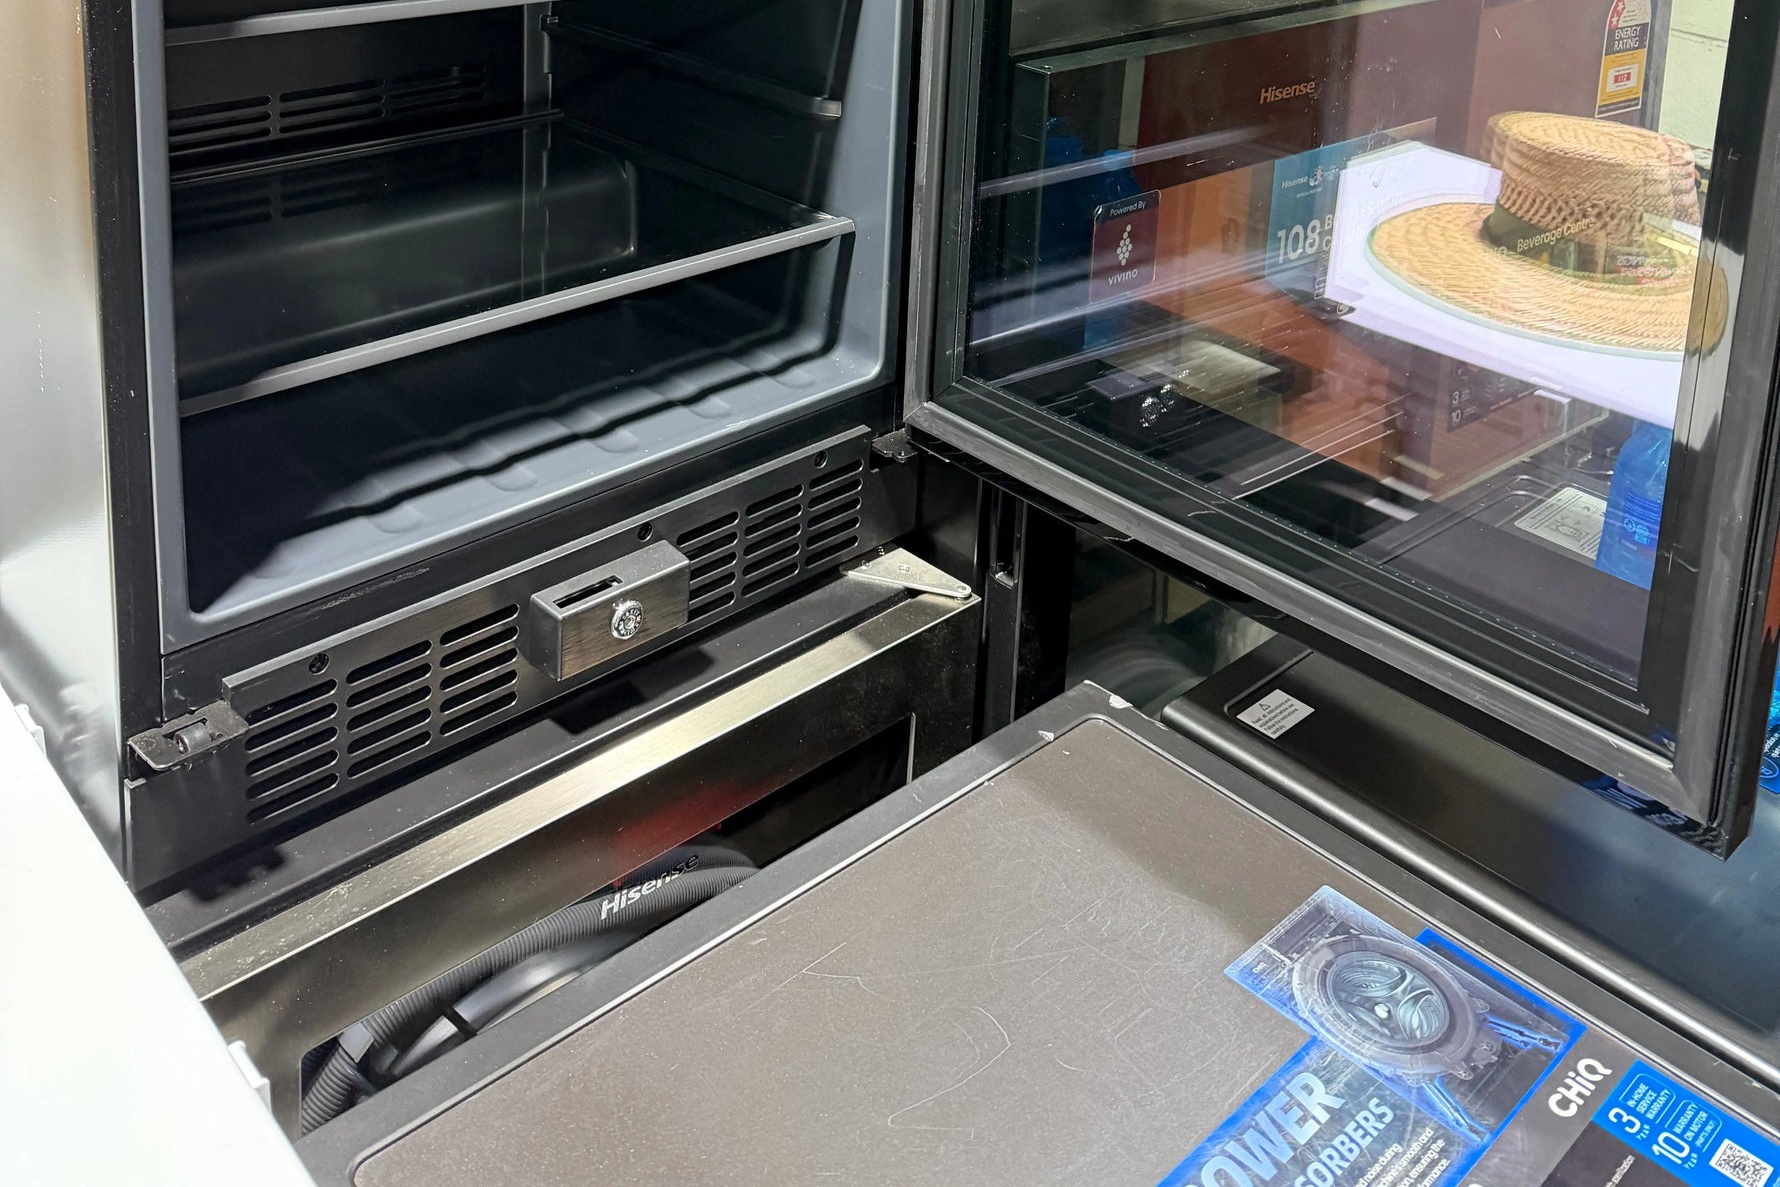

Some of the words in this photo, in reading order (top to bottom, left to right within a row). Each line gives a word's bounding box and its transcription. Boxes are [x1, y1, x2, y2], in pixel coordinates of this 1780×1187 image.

[1613, 37, 1640, 51] RATING
[1615, 26, 1641, 40] ENERGY
[1260, 80, 1316, 104] Hisense
[1109, 204, 1137, 217] Powered
[1137, 200, 1147, 210] By
[1276, 219, 1321, 264] 108
[1516, 228, 1563, 253] Beverage
[1563, 216, 1596, 237] Centre
[1108, 269, 1138, 286] vivino
[600, 855, 699, 920] Hisense
[1548, 1058, 1612, 1117] CHiQ
[1626, 1083, 1649, 1109] IN-HOME
[1636, 1090, 1657, 1114] SERVICE
[1645, 1089, 1671, 1120] WARRANTY
[1184, 1072, 1346, 1187] OWER
[1608, 1107, 1641, 1133] 3
[1635, 1124, 1650, 1140] YEAR
[1673, 1103, 1699, 1134] WARRANTY
[1683, 1130, 1695, 1141] ON
[1689, 1111, 1709, 1134] MOTOR
[1379, 1143, 1403, 1165] during
[1399, 1141, 1423, 1167] smooth
[1419, 1127, 1434, 1144] and
[1409, 1149, 1439, 1179] ensuring
[1430, 1139, 1445, 1152] the
[1652, 1131, 1690, 1164] 10
[1683, 1152, 1698, 1169] YEAR
